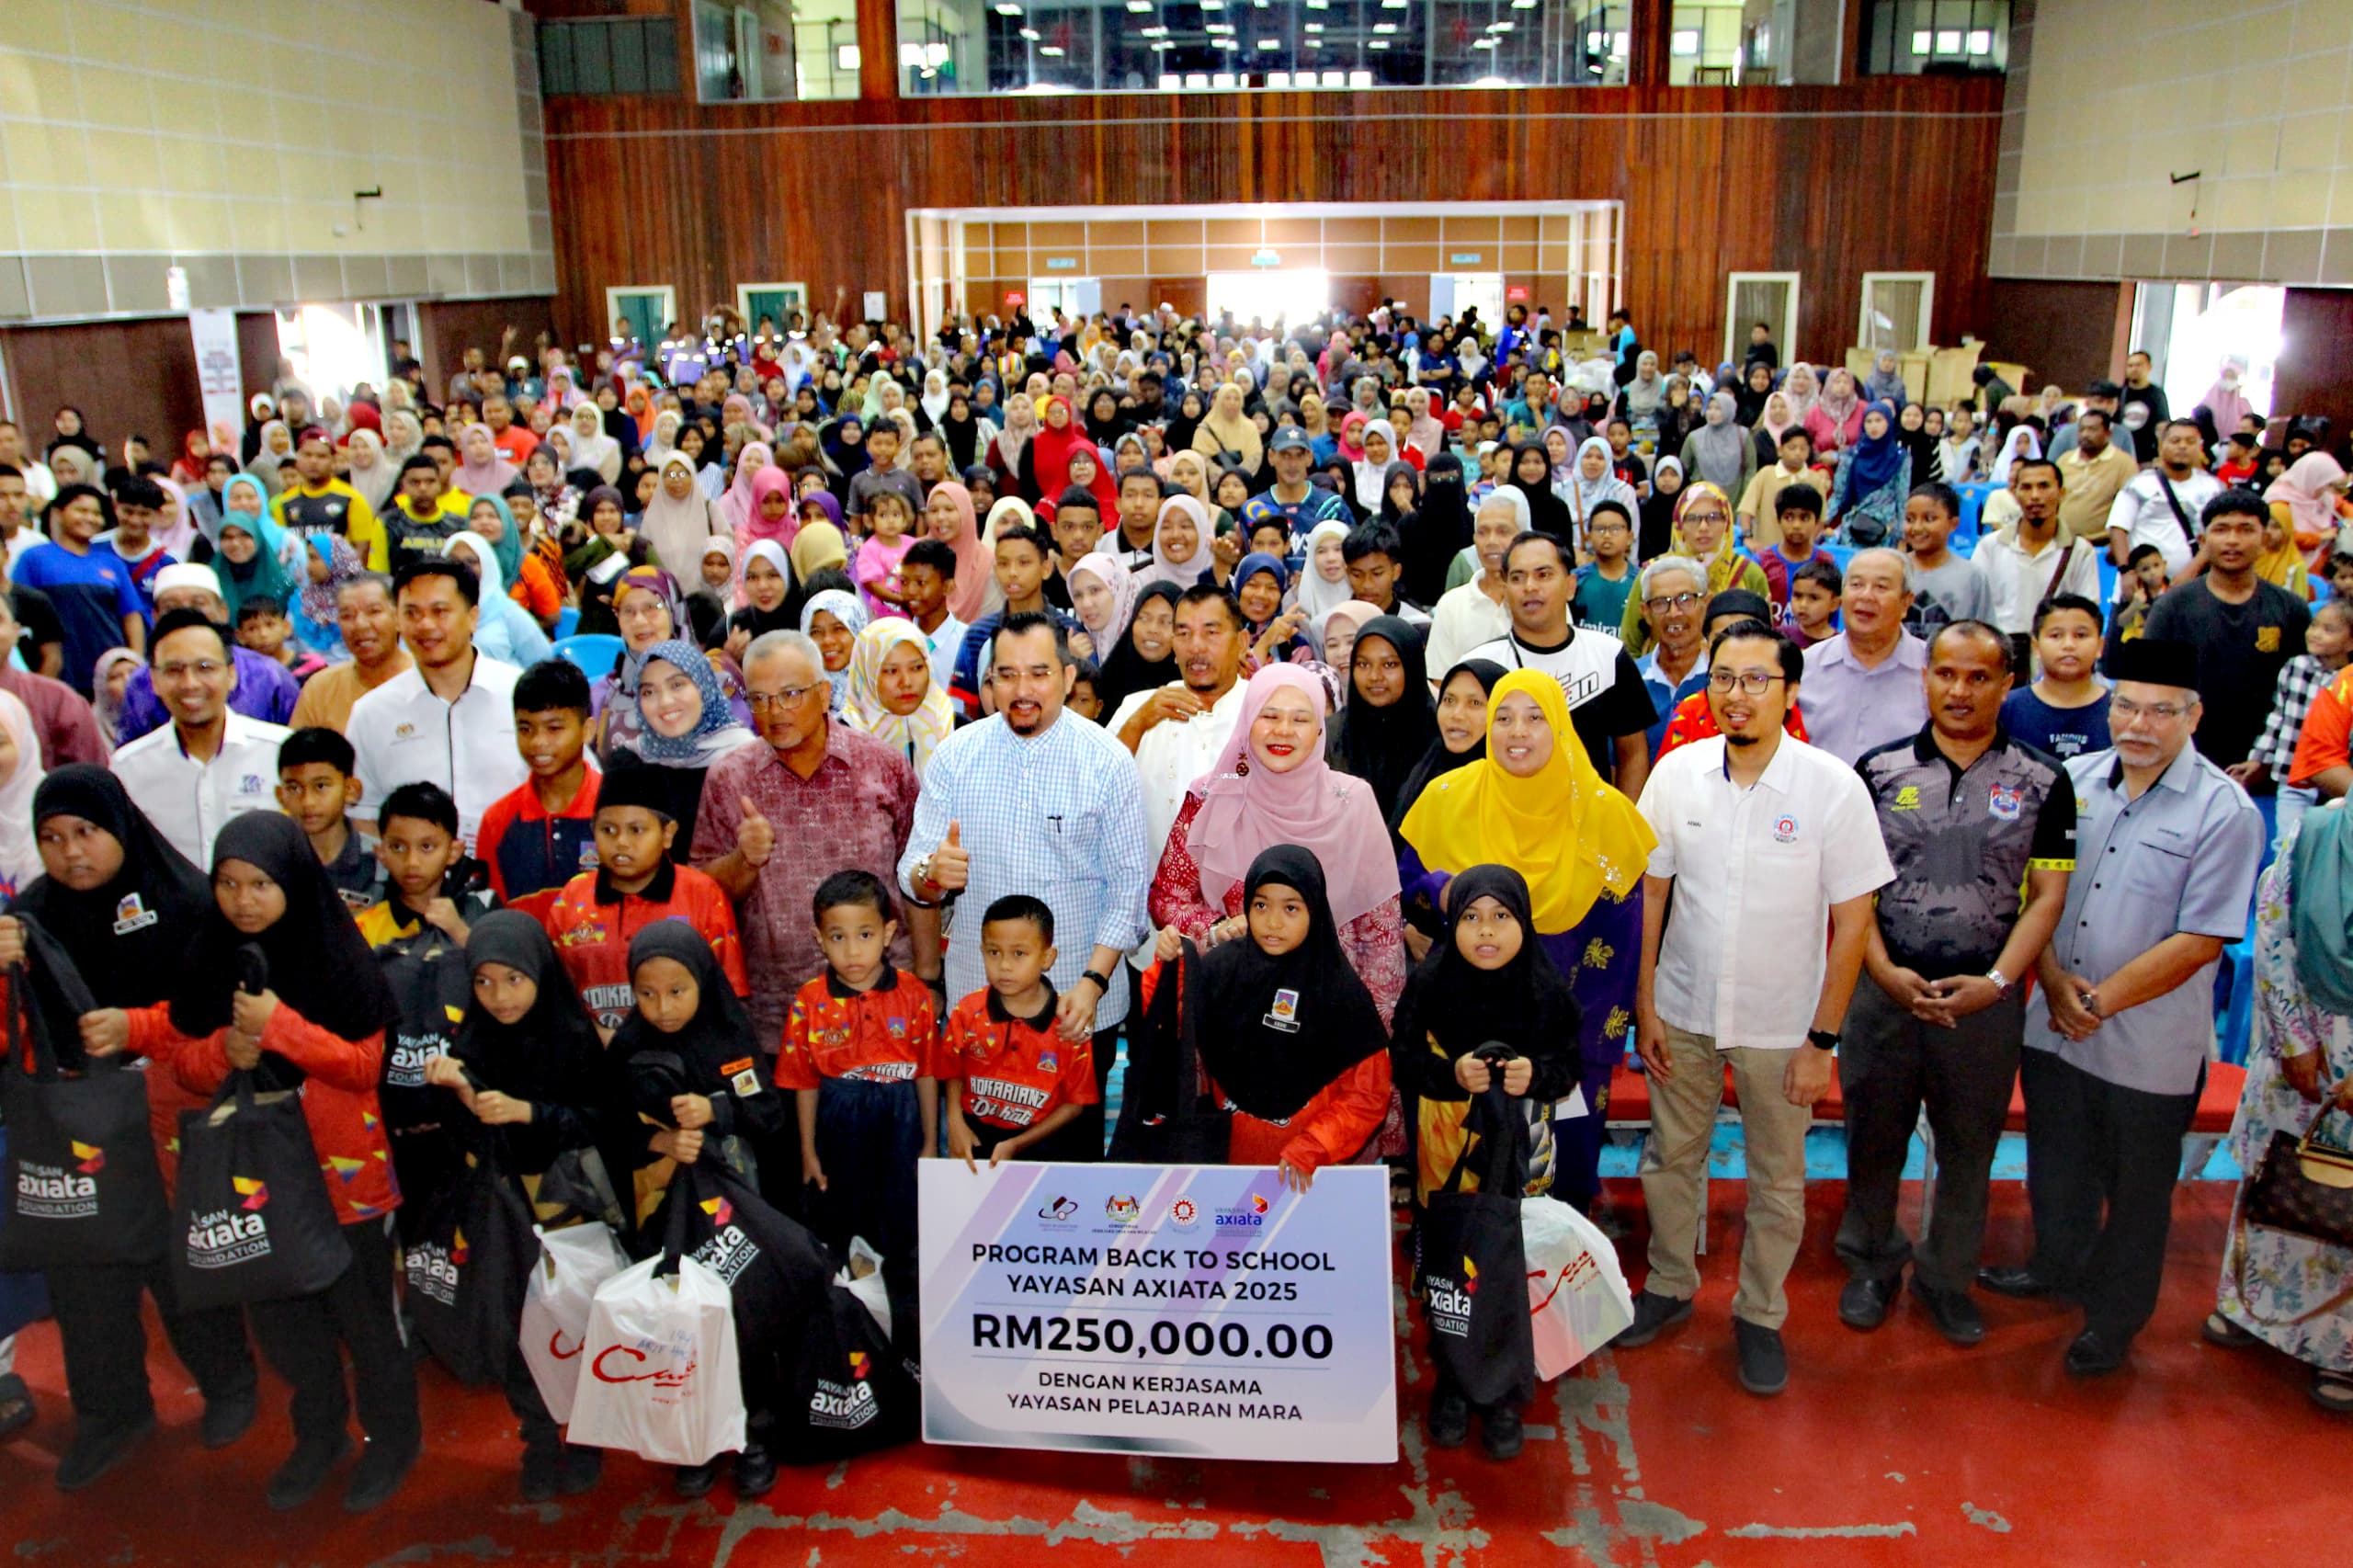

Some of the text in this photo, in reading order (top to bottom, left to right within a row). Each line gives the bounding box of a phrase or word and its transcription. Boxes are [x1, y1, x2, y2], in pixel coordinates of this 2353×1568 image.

[17, 1174, 97, 1199] axiata
[1215, 1212, 1262, 1226] axiata
[972, 1243, 1336, 1271] PROGRAM BACK TO SCHOOL
[1006, 1274, 1298, 1301] YAYASAN AXIATA 2025
[1430, 1290, 1471, 1317] xiata
[972, 1312, 1334, 1359] RM250,000.00
[1039, 1371, 1263, 1395] DENGAN KERJASAMA
[810, 1381, 872, 1415] axiata
[1007, 1393, 1302, 1421] YAYASAN PELAJARAN MARA
